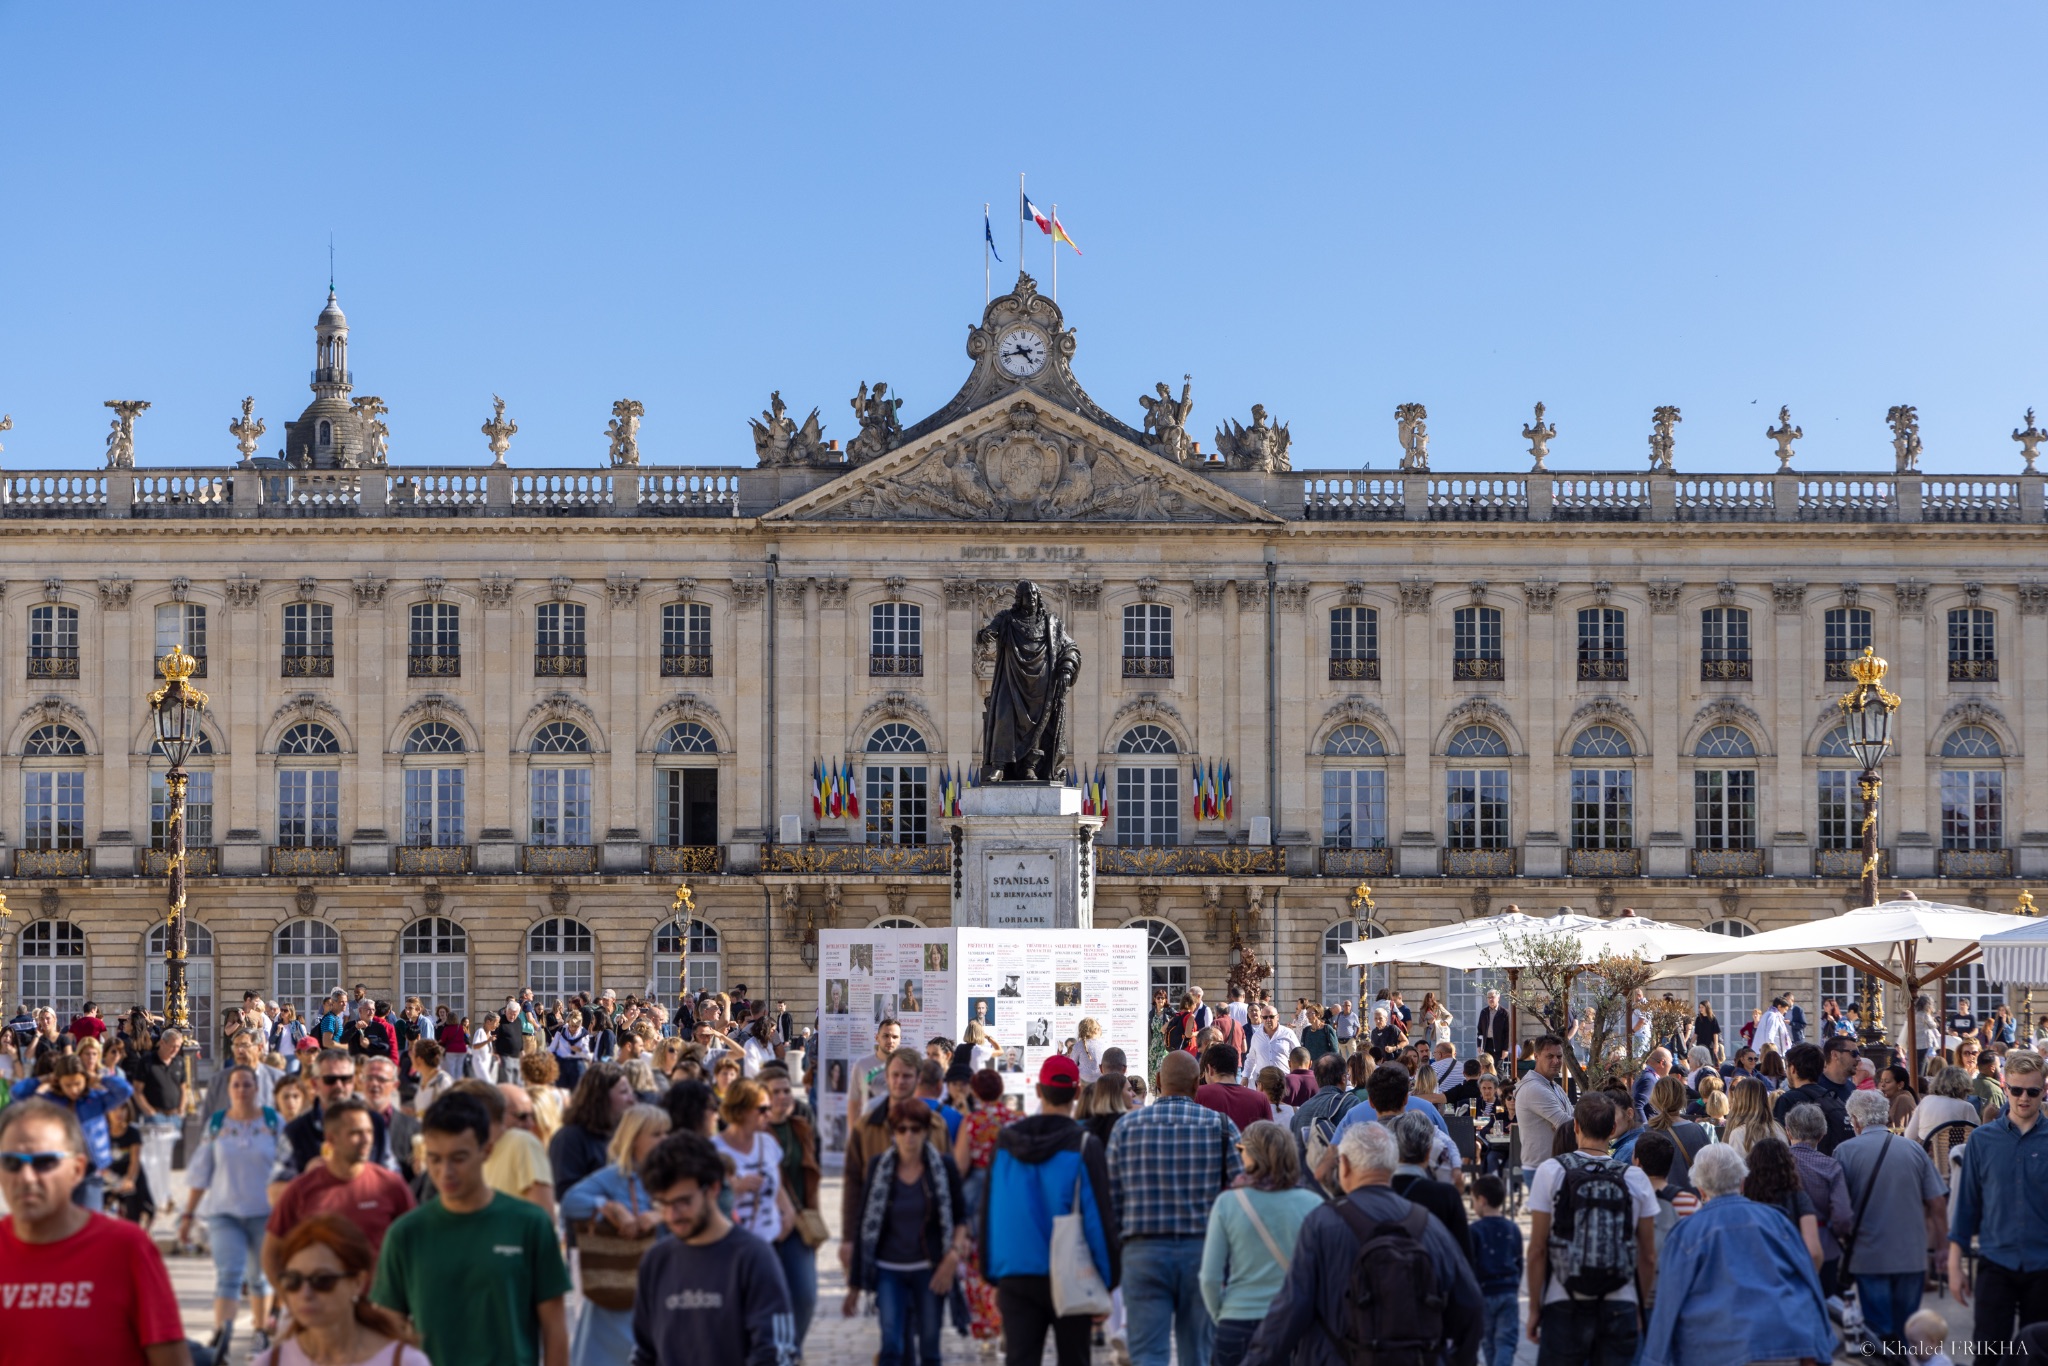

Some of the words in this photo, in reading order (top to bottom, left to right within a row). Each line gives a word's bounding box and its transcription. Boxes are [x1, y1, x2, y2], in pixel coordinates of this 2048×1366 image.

[1016, 546, 1037, 559] DE
[1044, 546, 1086, 559] VILLE
[1018, 862, 1026, 870] A
[993, 877, 1049, 885] STANISLAS
[0, 1281, 94, 1310] VERSE
